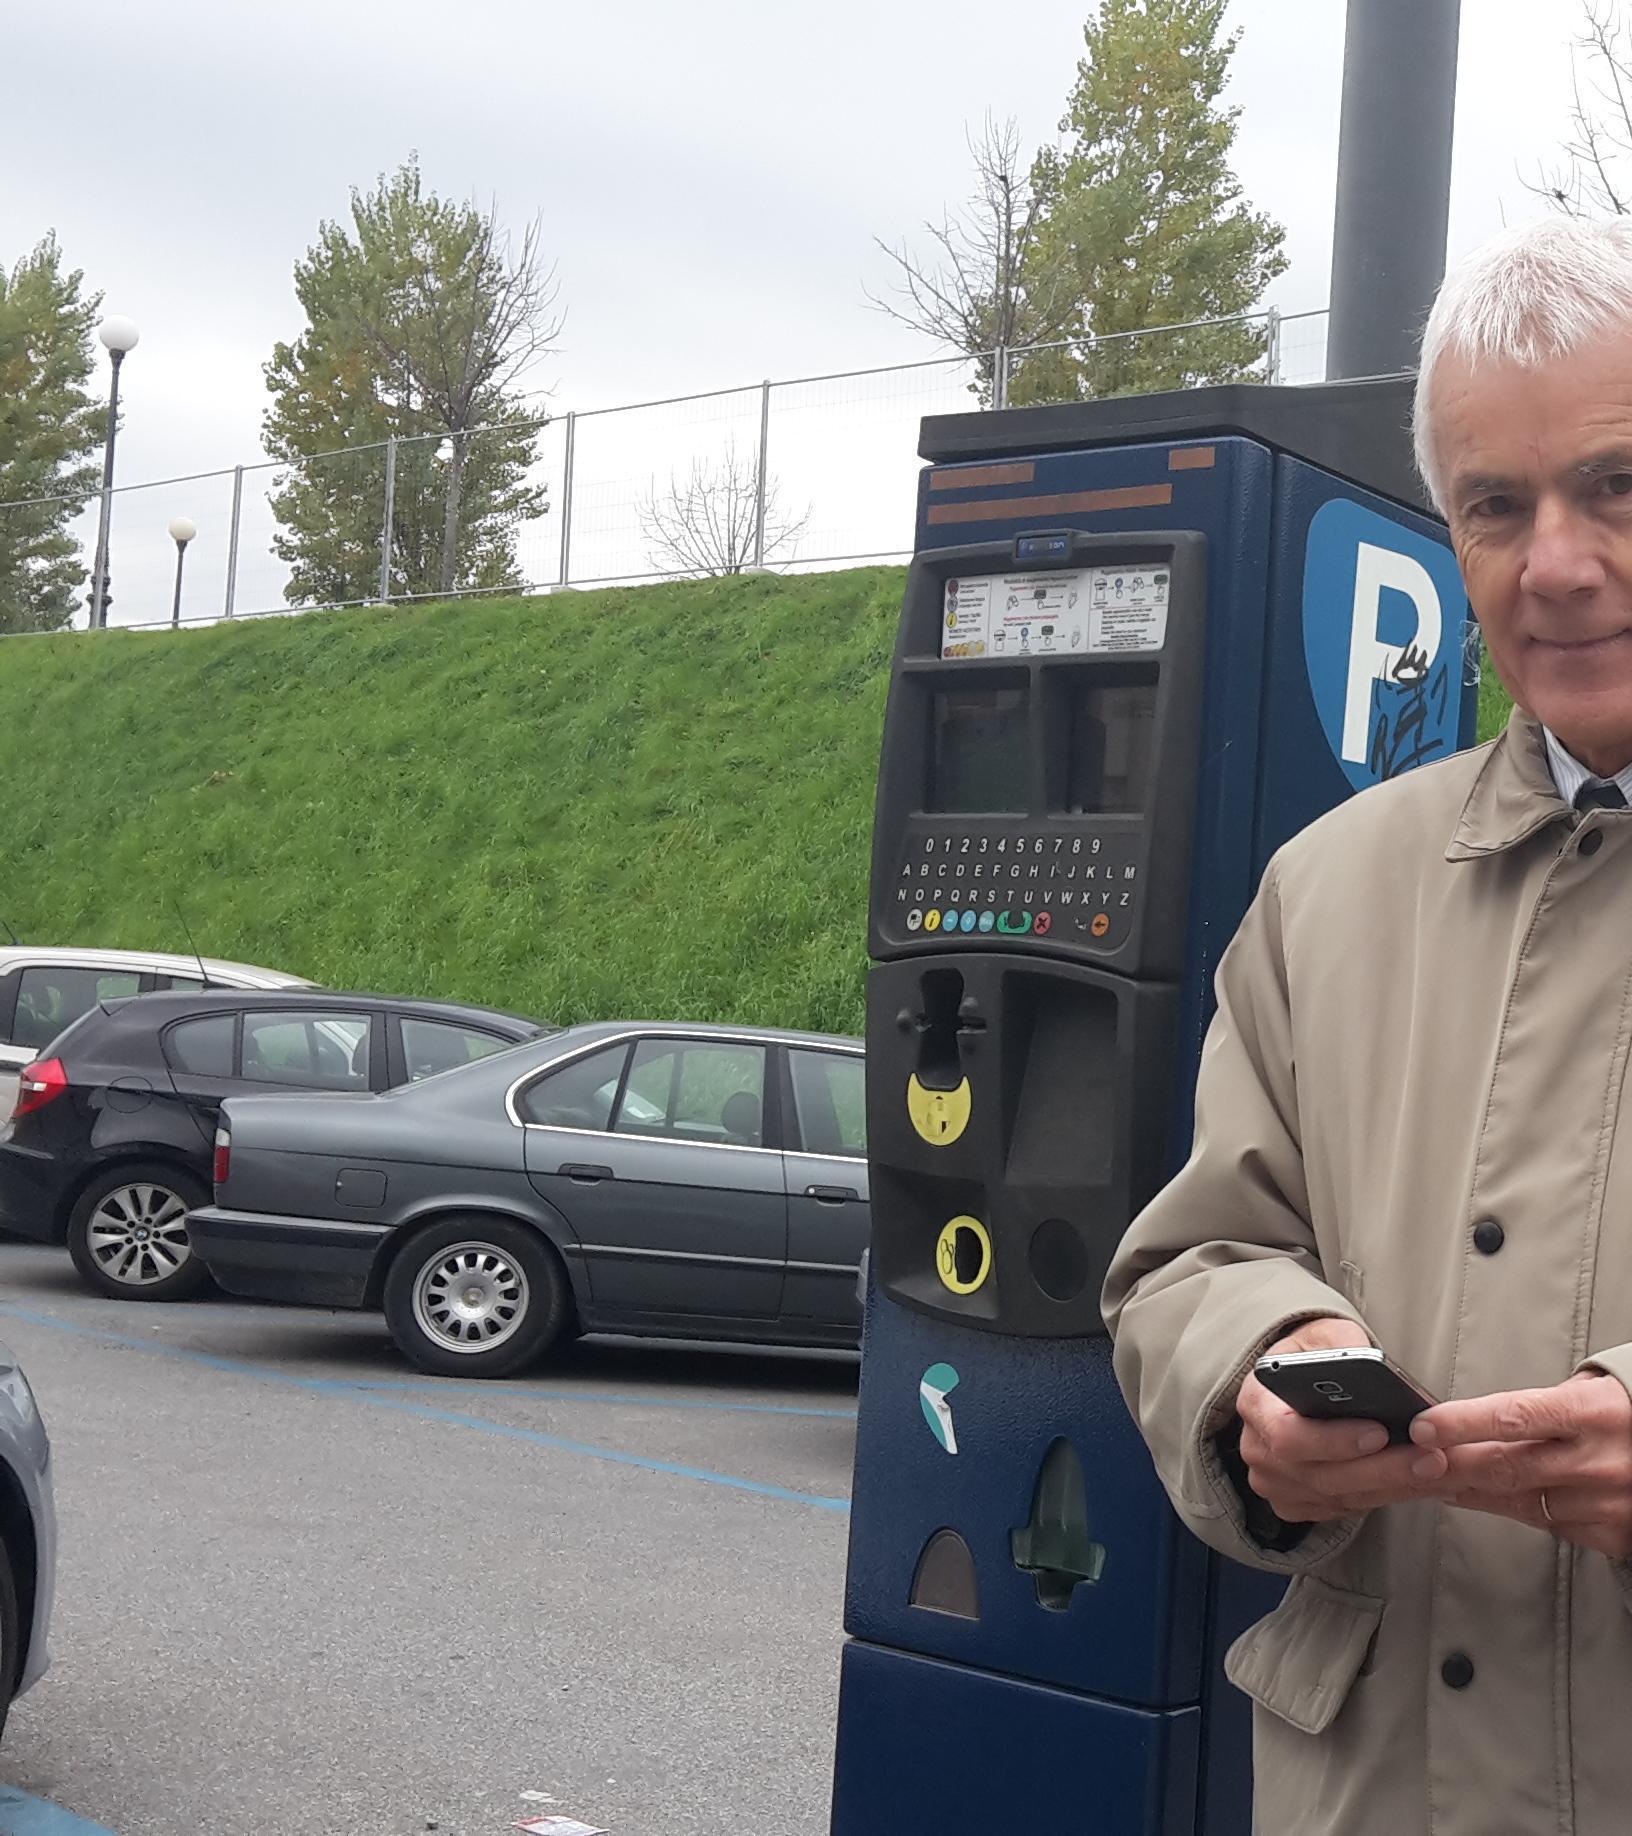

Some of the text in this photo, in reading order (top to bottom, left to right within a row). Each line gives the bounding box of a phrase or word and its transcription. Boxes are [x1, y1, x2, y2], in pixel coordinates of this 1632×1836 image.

[1341, 541, 1443, 765] P
[925, 838, 1101, 854] 0 1 2 3 4 5 6 7 8 9
[902, 863, 1136, 880] A B C D E F G H I J K L M
[897, 888, 1130, 906] N O P Q R S T U V W X Y Z
